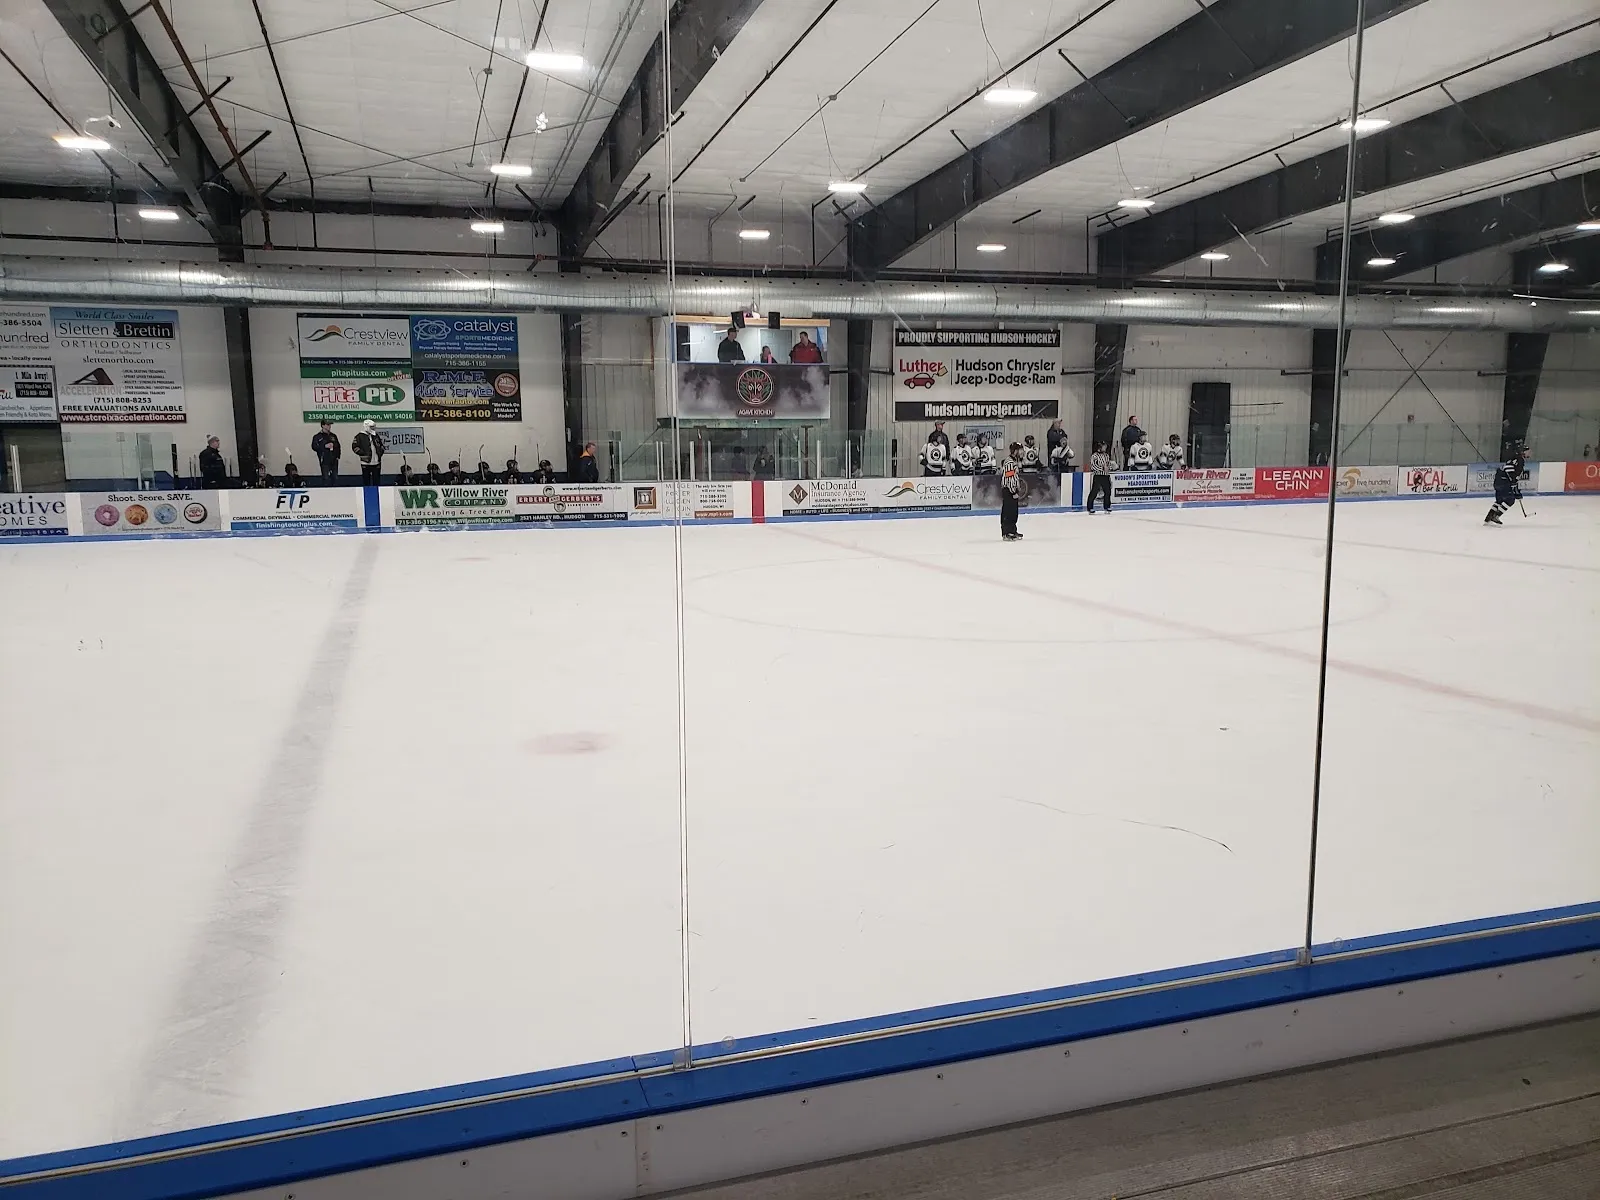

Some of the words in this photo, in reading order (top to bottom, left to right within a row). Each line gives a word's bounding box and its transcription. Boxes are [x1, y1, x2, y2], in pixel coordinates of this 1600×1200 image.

[75, 311, 101, 319] World
[104, 311, 125, 319] Class
[129, 312, 154, 320] Smiles
[60, 322, 109, 336] Sletten
[123, 324, 171, 337] Brettin
[453, 319, 515, 334] catalyst
[344, 327, 408, 340] Crestview
[898, 331, 936, 344] PROUDLY
[937, 332, 989, 344] SUPPORTING
[990, 332, 1025, 344] HUDSON
[1026, 332, 1057, 344] HOCKEY
[61, 339, 171, 349] ORTHODONTICS
[82, 356, 154, 364] slettenortho.com
[899, 358, 943, 373] Luther
[955, 358, 1003, 371] Hudson
[1006, 358, 1056, 373] Chrysler
[331, 369, 387, 378] pitapitusa.com
[60, 385, 122, 396] ACCELERATION
[314, 386, 360, 403] Pita
[366, 387, 397, 403] Pit
[415, 382, 447, 397] Auto
[450, 382, 495, 398] Service
[421, 409, 491, 418] 715-386-8100
[924, 402, 1032, 418] HudsonChrysler.net
[61, 413, 185, 422] www.stcroixacceleration.com
[324, 413, 345, 421] Badger
[391, 433, 422, 445] GUEST
[1176, 470, 1204, 480] Willow
[1206, 470, 1229, 479] River
[1263, 469, 1323, 481] LEEANN
[1407, 470, 1447, 486] LOCAL
[811, 480, 857, 491] McDonald
[916, 483, 971, 494] Crestview
[1275, 480, 1309, 490] CHIN
[1443, 483, 1458, 492] Grill
[108, 494, 136, 502] Shoot.
[138, 494, 165, 502] Score.
[167, 493, 193, 501] SAVE.
[441, 487, 479, 498] Willow
[482, 487, 508, 497] River
[843, 490, 866, 498] Agency
[276, 490, 310, 510] FTP
[400, 488, 440, 509] WR
[561, 495, 600, 503] GERBERT'S
[0, 495, 66, 514] ative
[256, 521, 333, 530] finishingtouchplus.com
